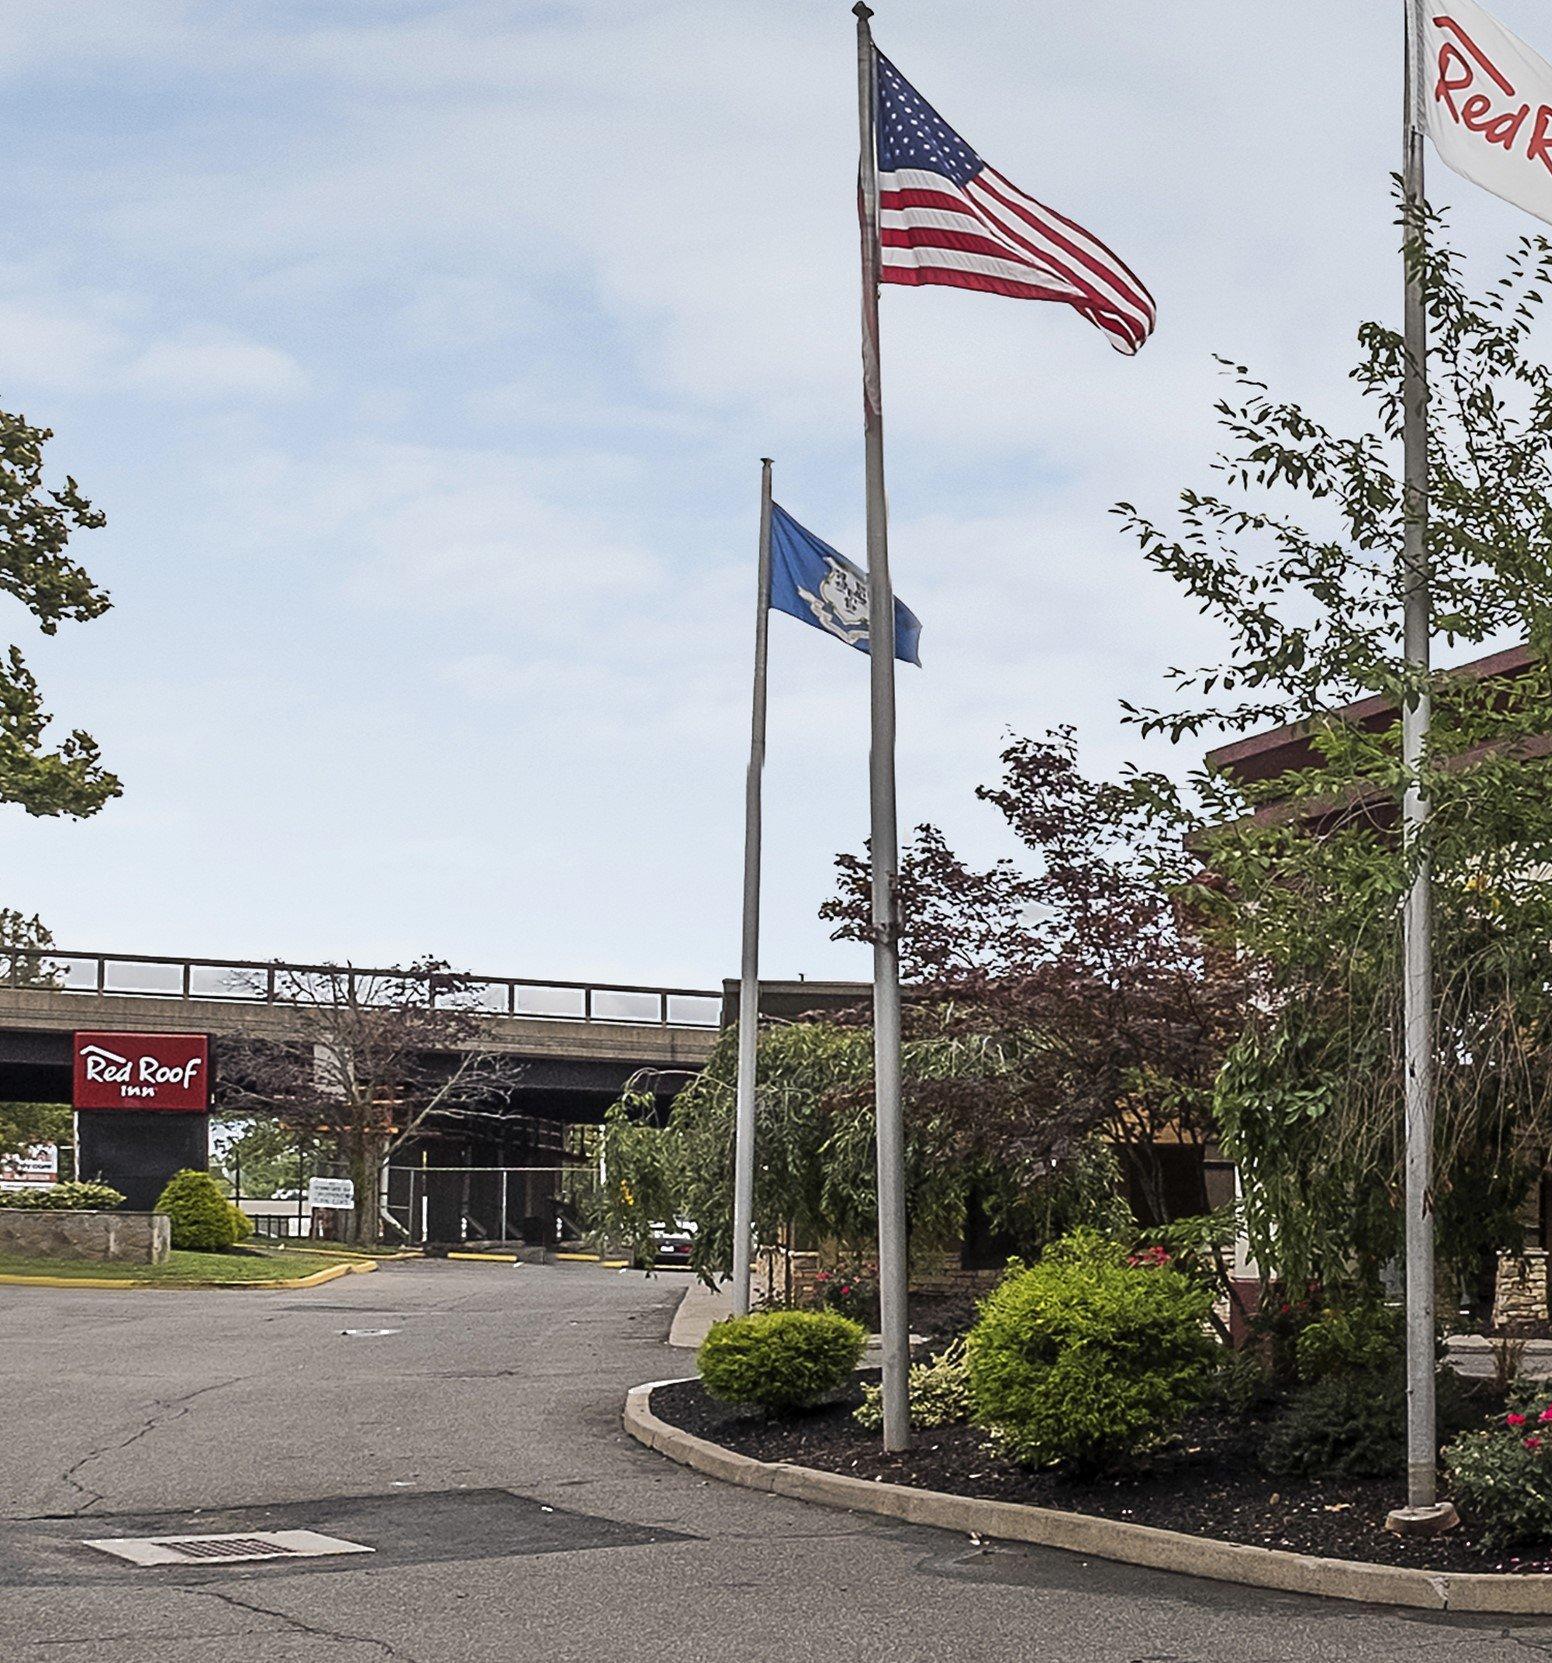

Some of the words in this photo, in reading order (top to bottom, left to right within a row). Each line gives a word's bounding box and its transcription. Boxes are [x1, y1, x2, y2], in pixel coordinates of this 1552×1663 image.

[1434, 41, 1530, 151] Red
[86, 1055, 133, 1083] Red
[139, 1056, 202, 1090] Roof
